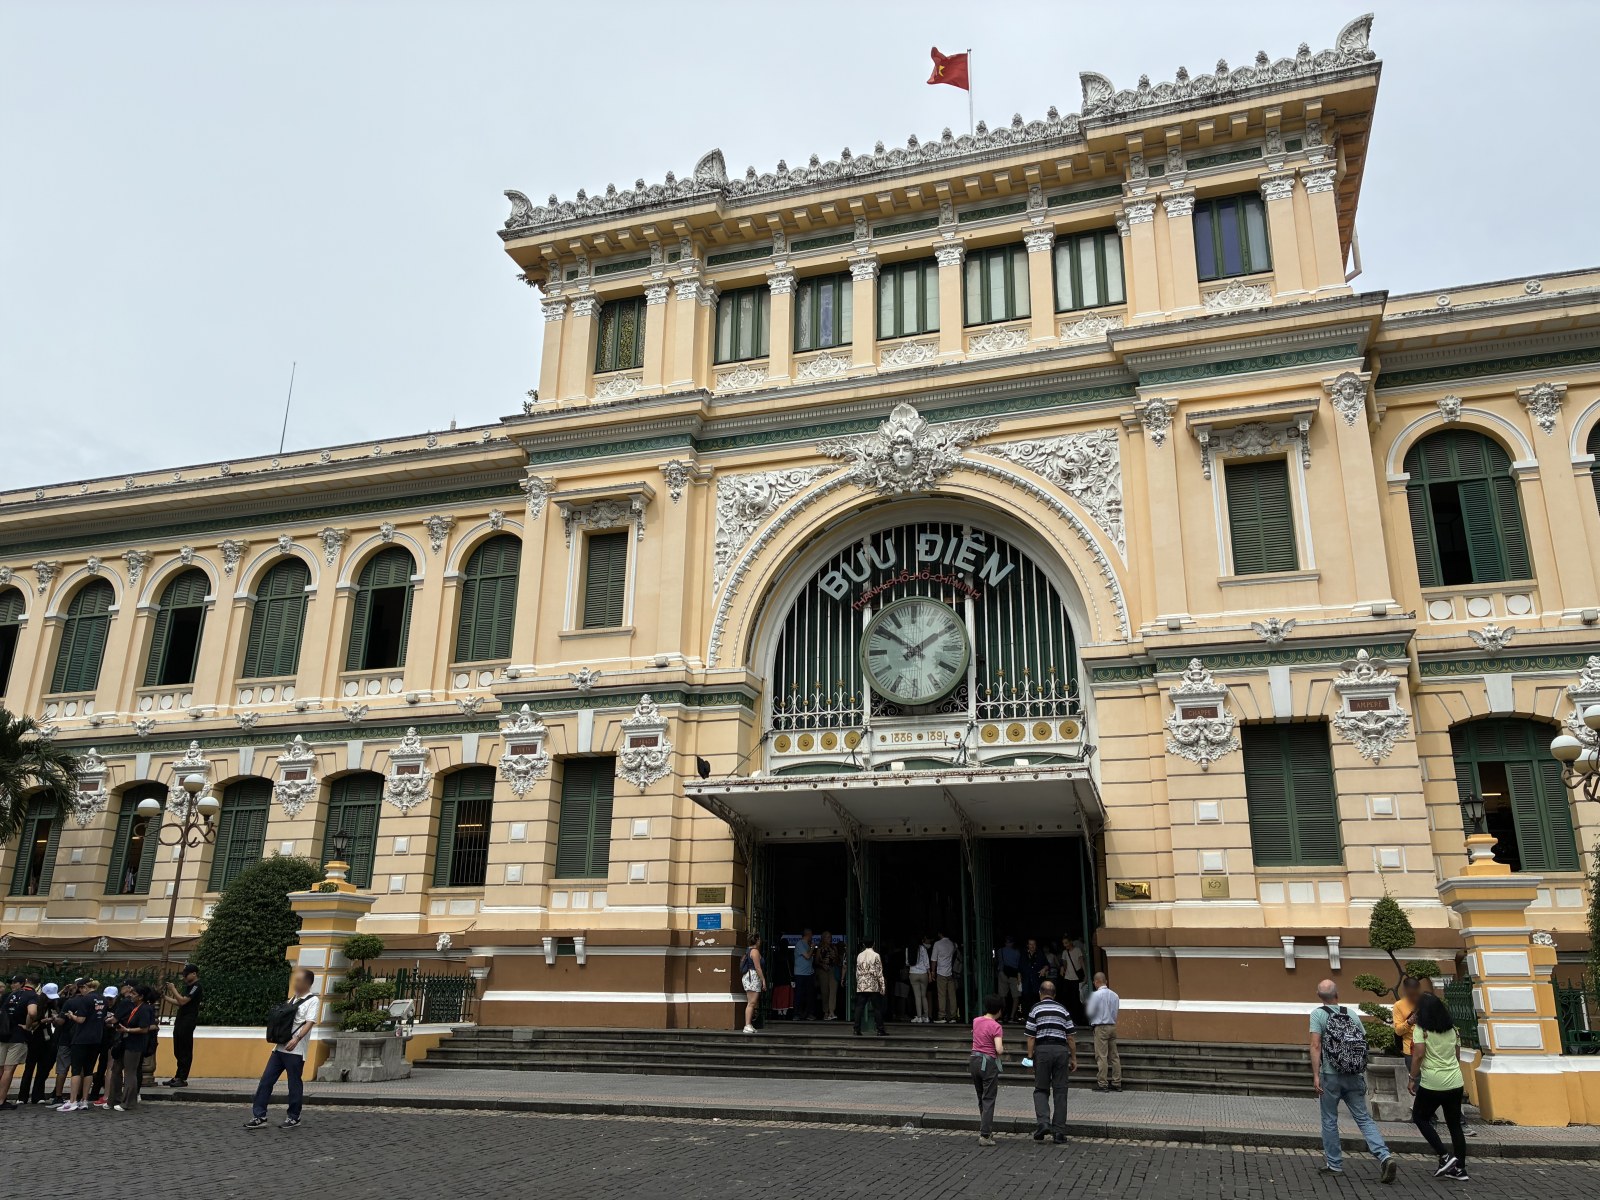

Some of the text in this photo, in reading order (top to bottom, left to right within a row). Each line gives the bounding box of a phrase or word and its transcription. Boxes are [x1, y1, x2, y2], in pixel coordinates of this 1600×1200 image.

[917, 533, 1016, 587] ĐIỆN
[891, 732, 913, 743] 1886
[926, 730, 947, 742] 1891
